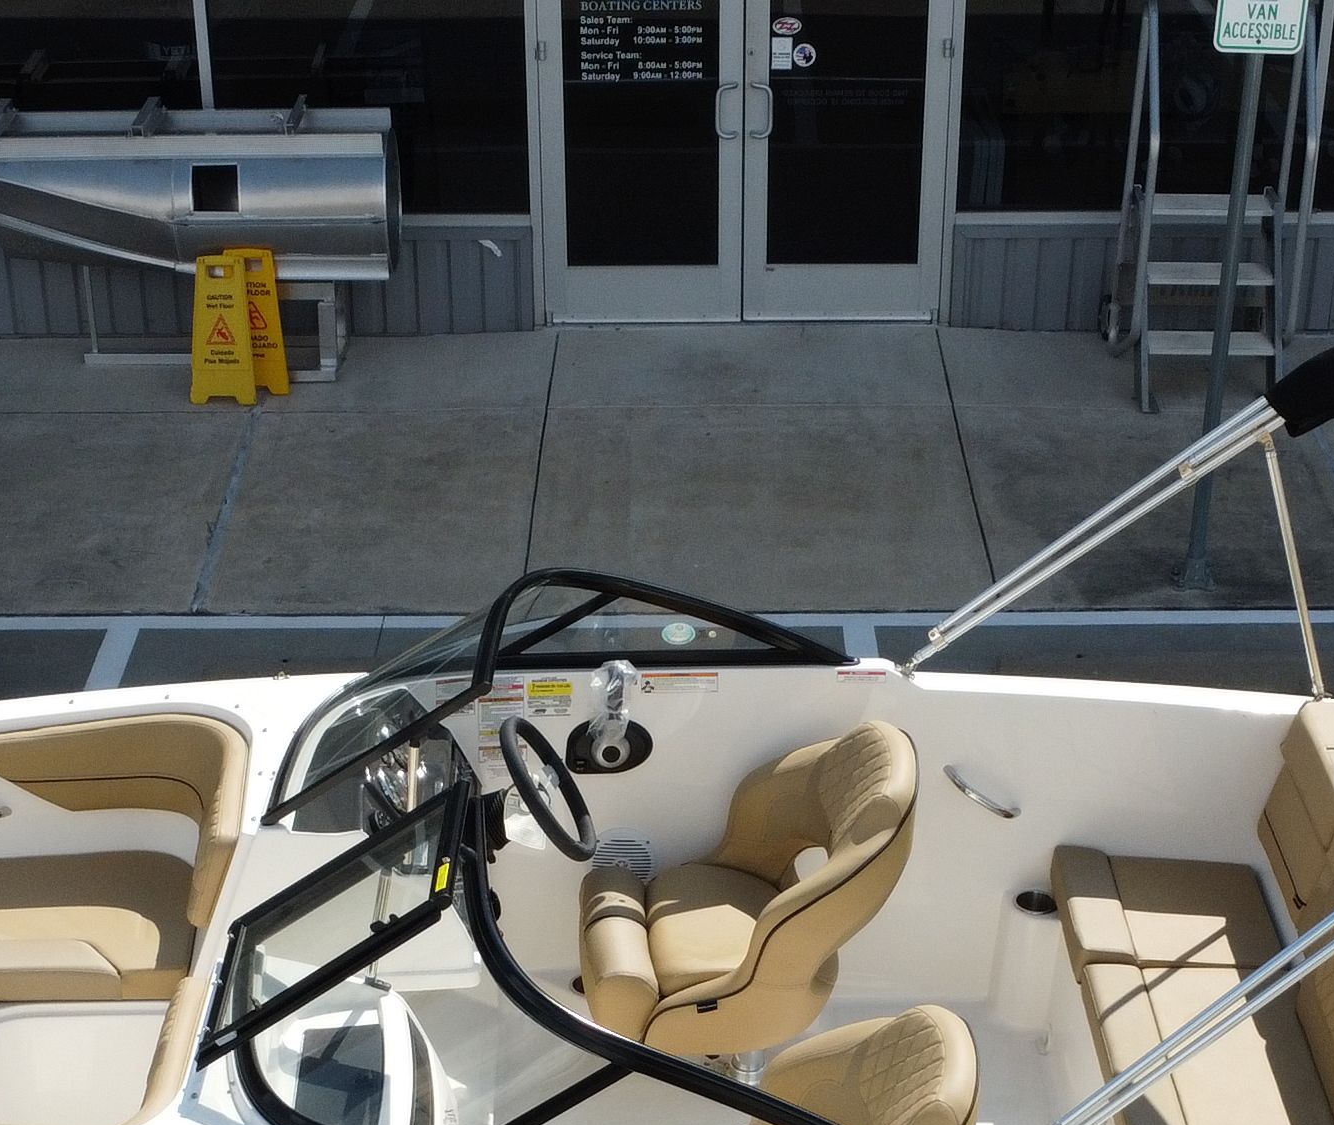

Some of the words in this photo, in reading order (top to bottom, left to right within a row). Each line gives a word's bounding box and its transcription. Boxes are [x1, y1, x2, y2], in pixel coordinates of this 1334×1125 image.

[580, 0, 641, 11] BOATING
[643, 0, 703, 10] CENTERS
[1247, 3, 1279, 20] VAN
[579, 15, 605, 24] Sales
[606, 15, 633, 24] Team:
[579, 26, 599, 35] Mon
[606, 26, 619, 35] Fri
[1222, 22, 1297, 40] ACCESSIBLE
[580, 37, 620, 47] Saturday
[580, 51, 614, 60] Service
[616, 51, 642, 59] Team:
[580, 61, 600, 70] Mon
[607, 61, 620, 70] Fri
[581, 72, 621, 82] Saturday
